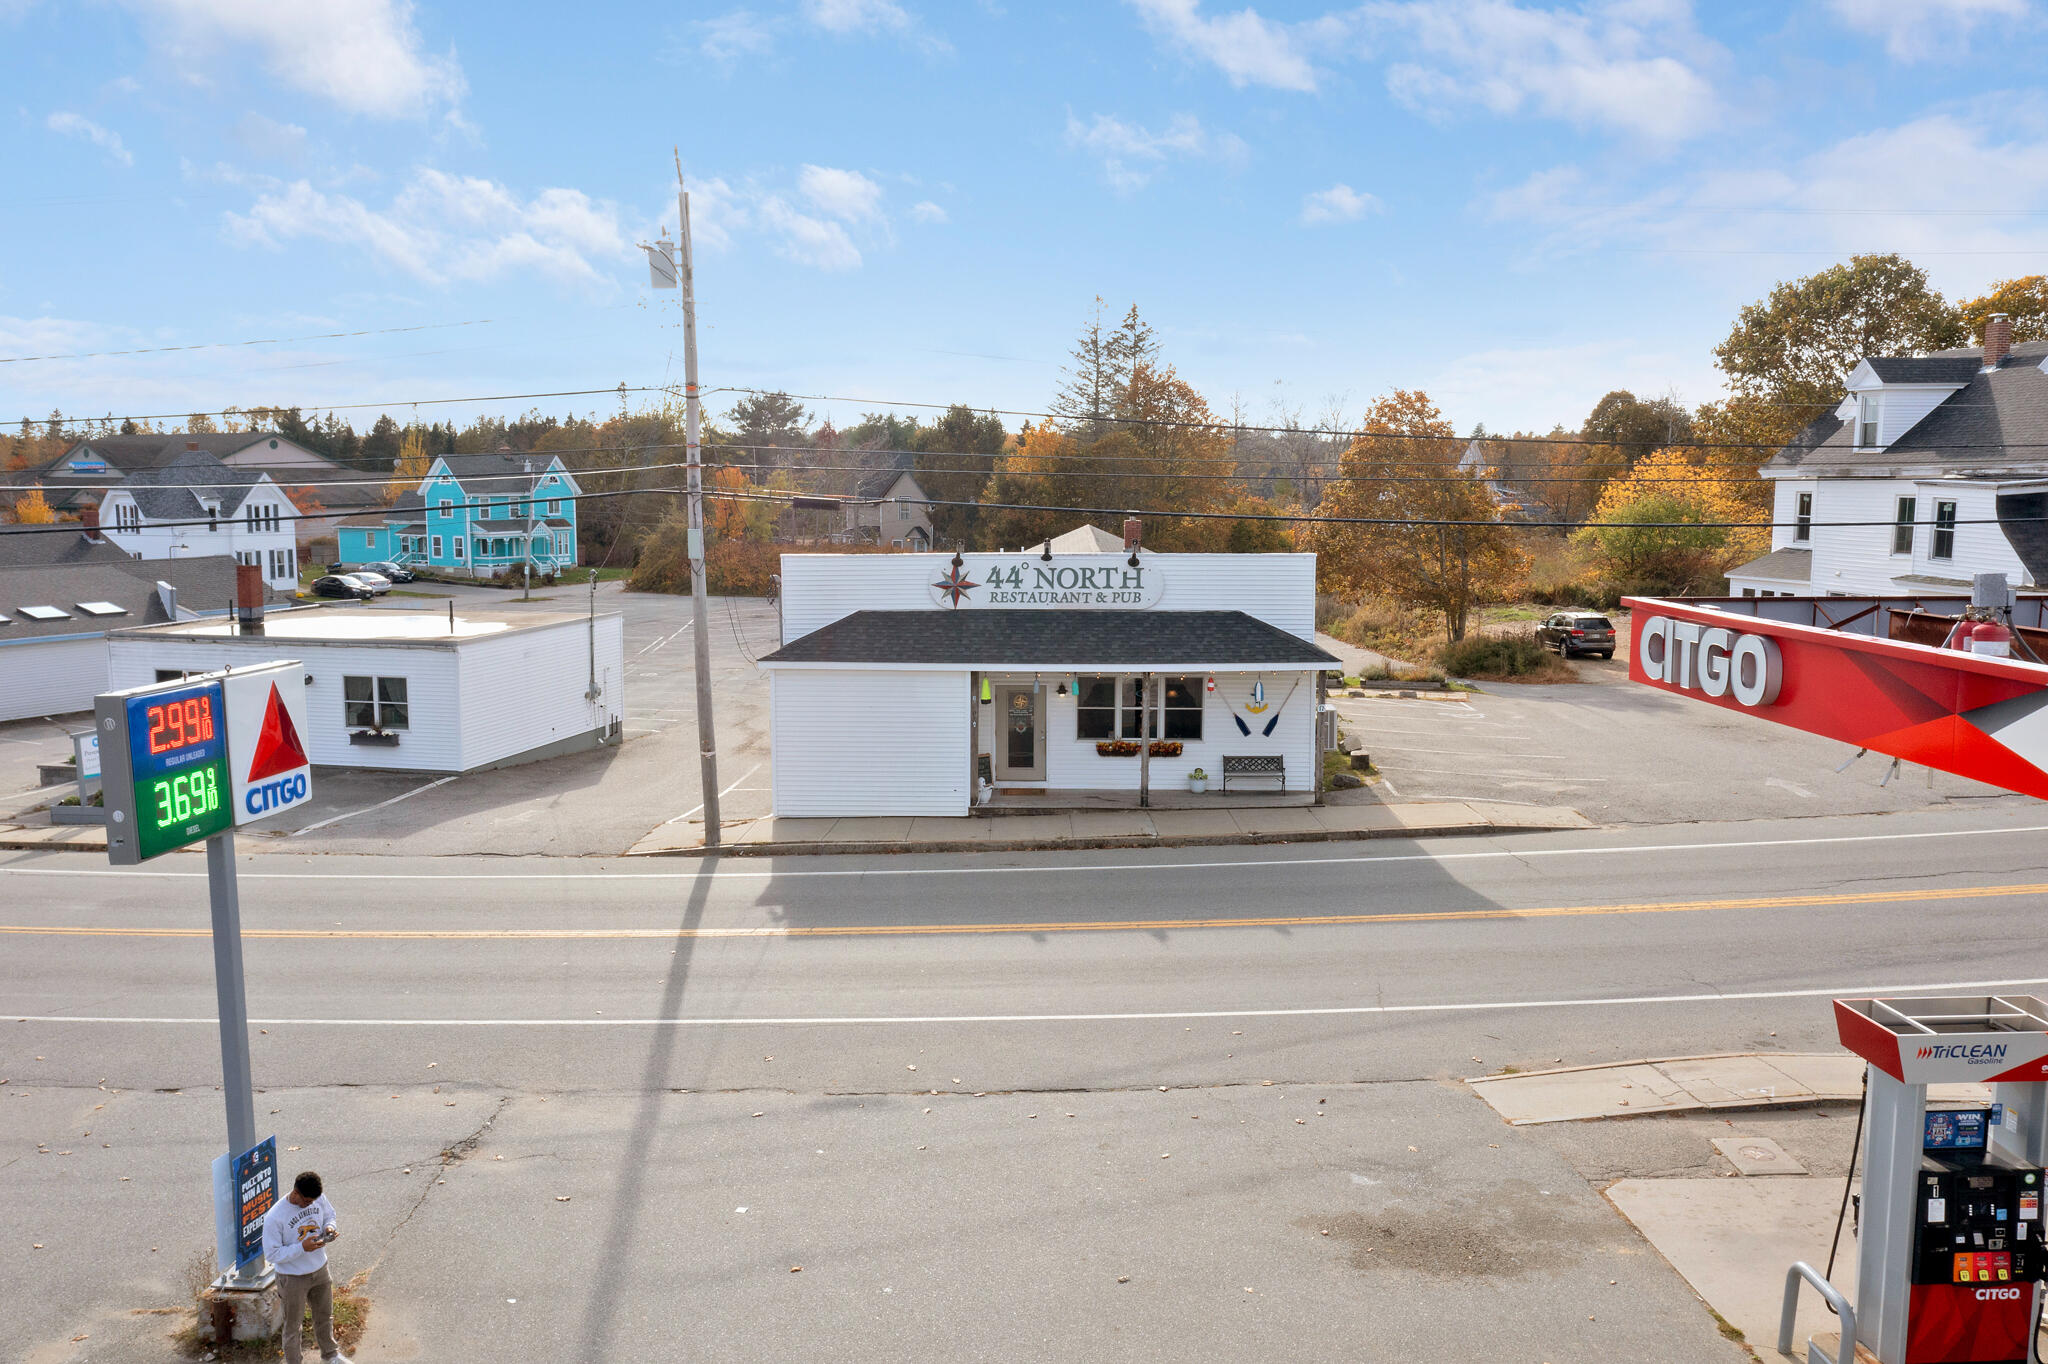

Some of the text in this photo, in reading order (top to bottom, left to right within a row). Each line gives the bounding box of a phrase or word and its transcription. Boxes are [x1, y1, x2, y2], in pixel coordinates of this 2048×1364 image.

[1033, 567, 1145, 590] NORTH
[990, 591, 1142, 604] RESTAURANT & PUB
[1640, 616, 1776, 706] CITGO
[147, 698, 201, 755] 2.99
[154, 770, 207, 828] 3.69
[245, 773, 307, 815] CITGO
[186, 824, 200, 836] DIESEL
[1933, 1044, 2007, 1058] TriCLEAN
[1967, 1057, 2004, 1065] Gasoline
[263, 1166, 272, 1178] TO
[242, 1187, 256, 1204] WIN
[260, 1177, 272, 1191] VIP
[242, 1188, 273, 1215] MUSIC
[242, 1198, 273, 1226] FEST
[243, 1215, 265, 1238] EXPERIE
[1975, 1288, 2020, 1300] CITGO
